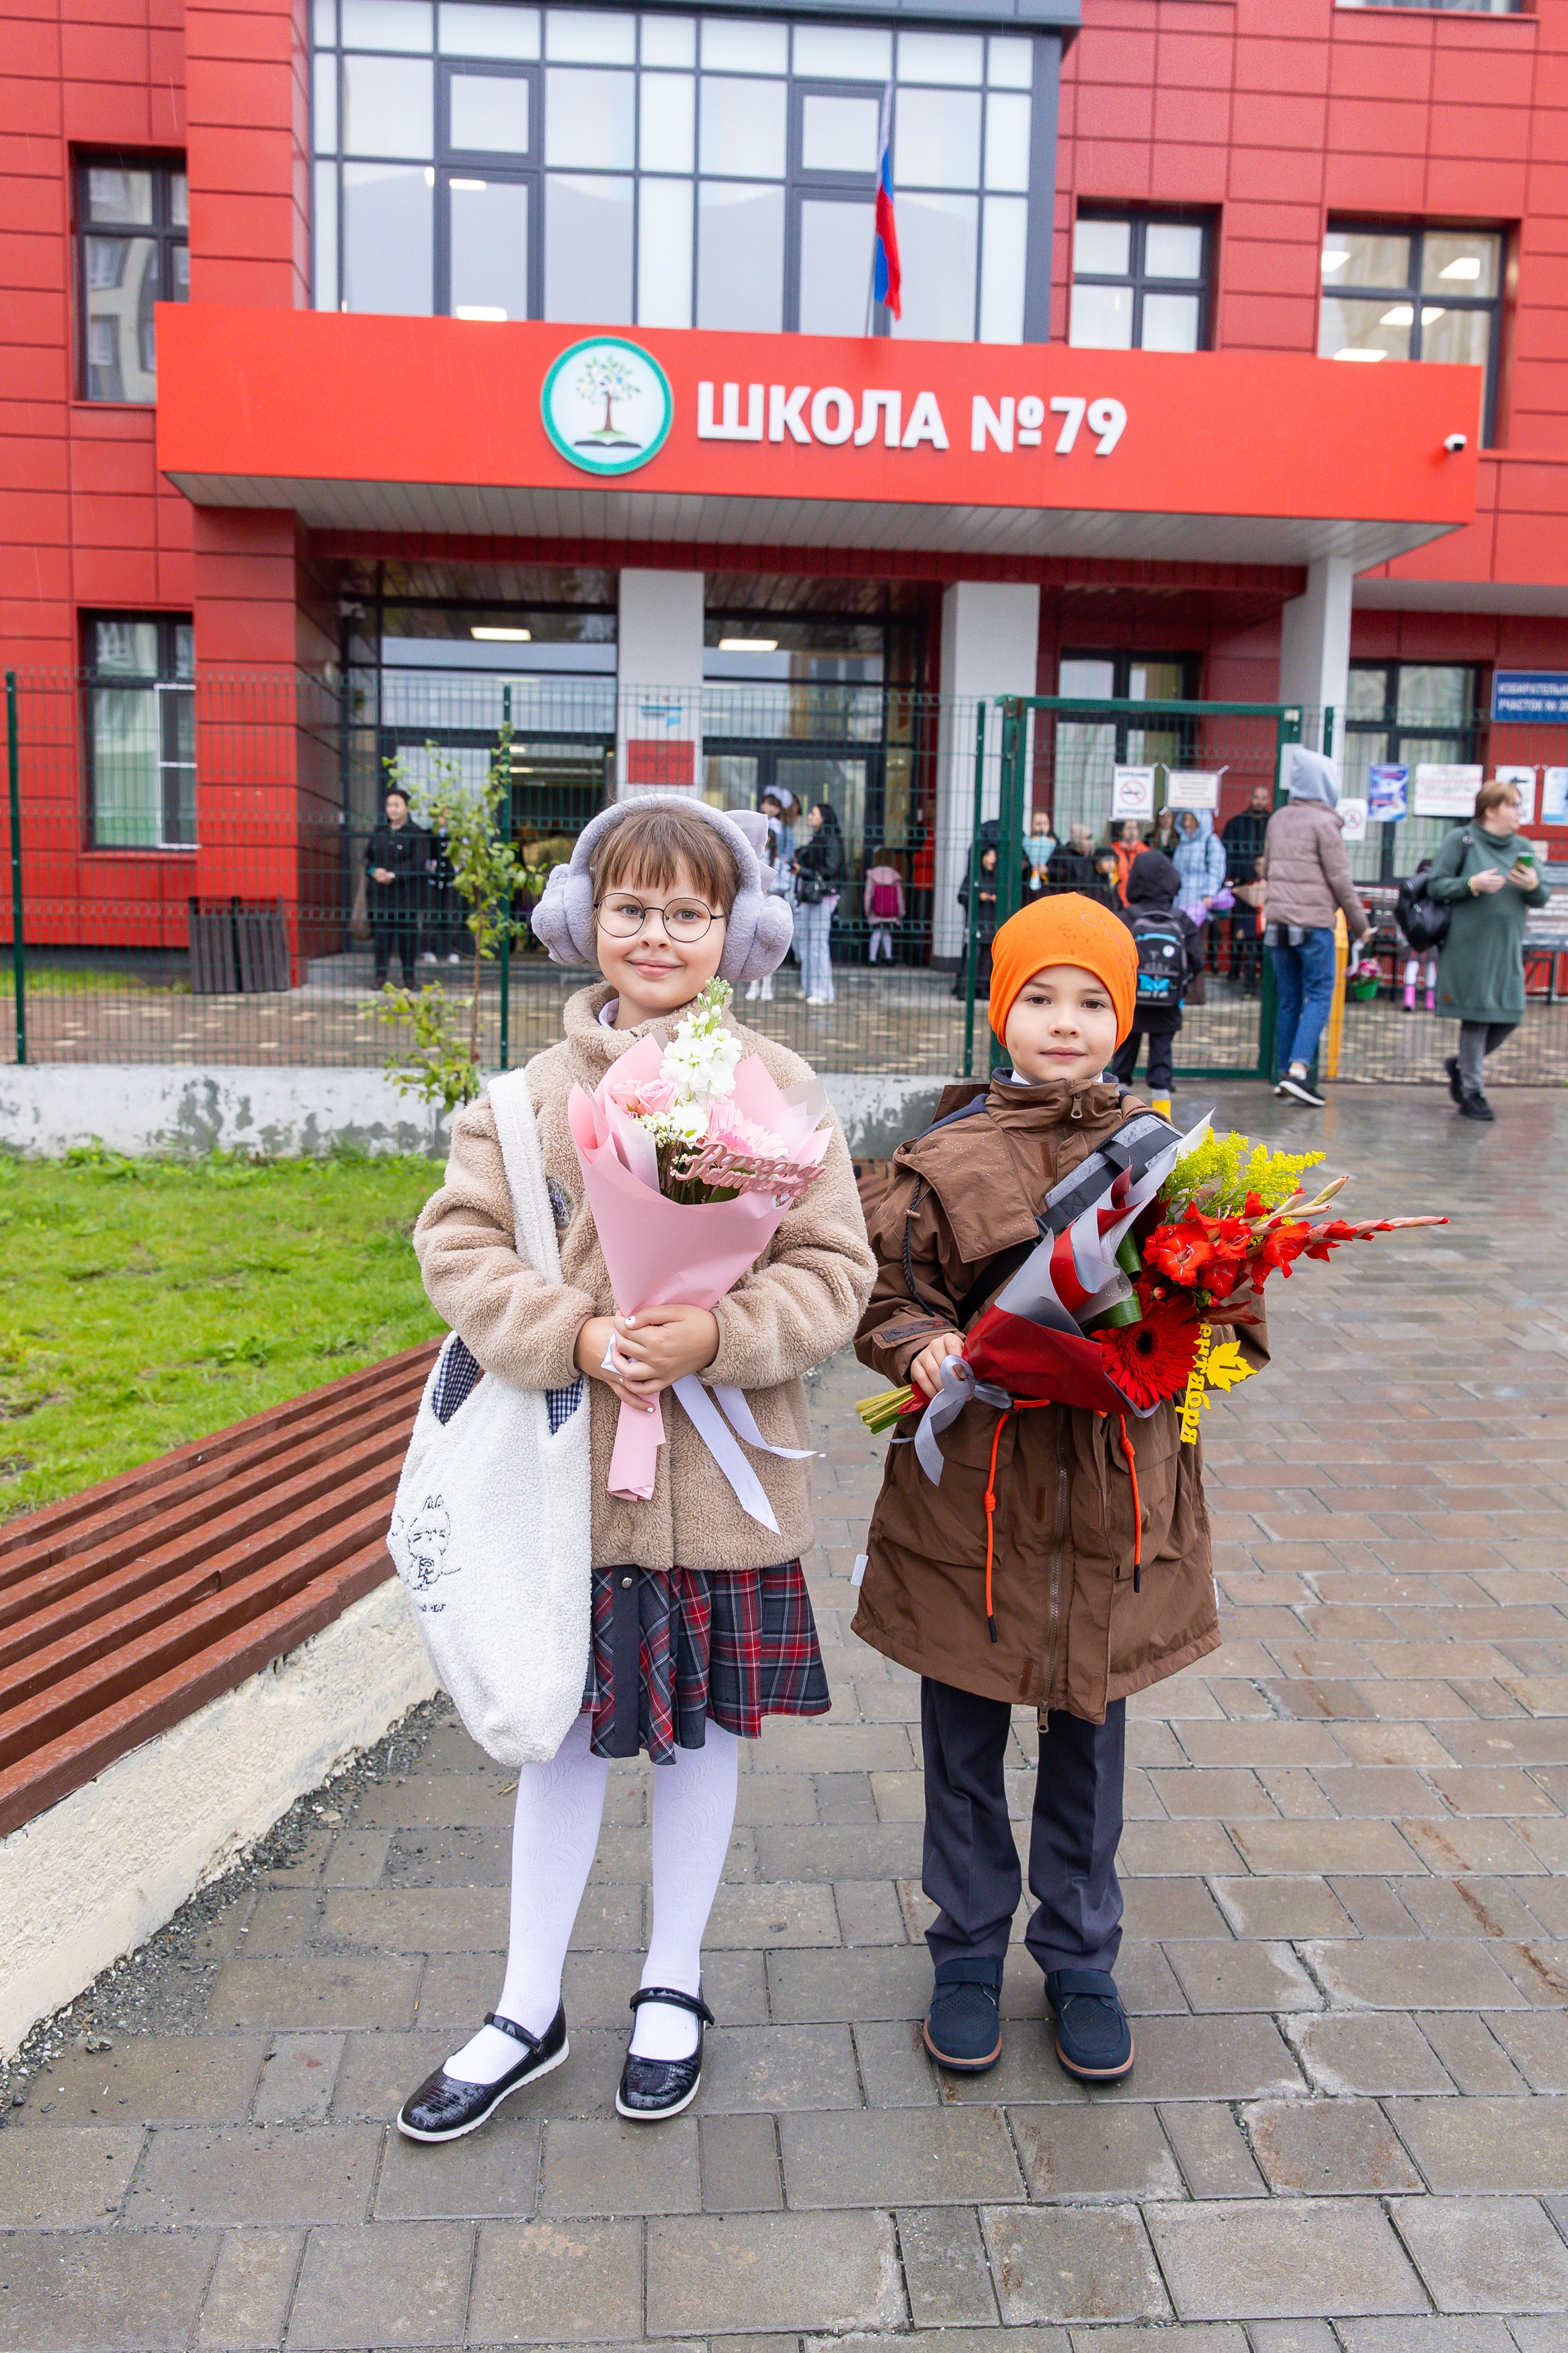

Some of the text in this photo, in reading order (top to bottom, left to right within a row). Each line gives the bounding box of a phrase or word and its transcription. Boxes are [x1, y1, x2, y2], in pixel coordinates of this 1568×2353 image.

[696, 381, 1128, 456] ШКОЛА №79
[1175, 1322, 1212, 1445] ентября
[1219, 1363, 1243, 1371] 1
